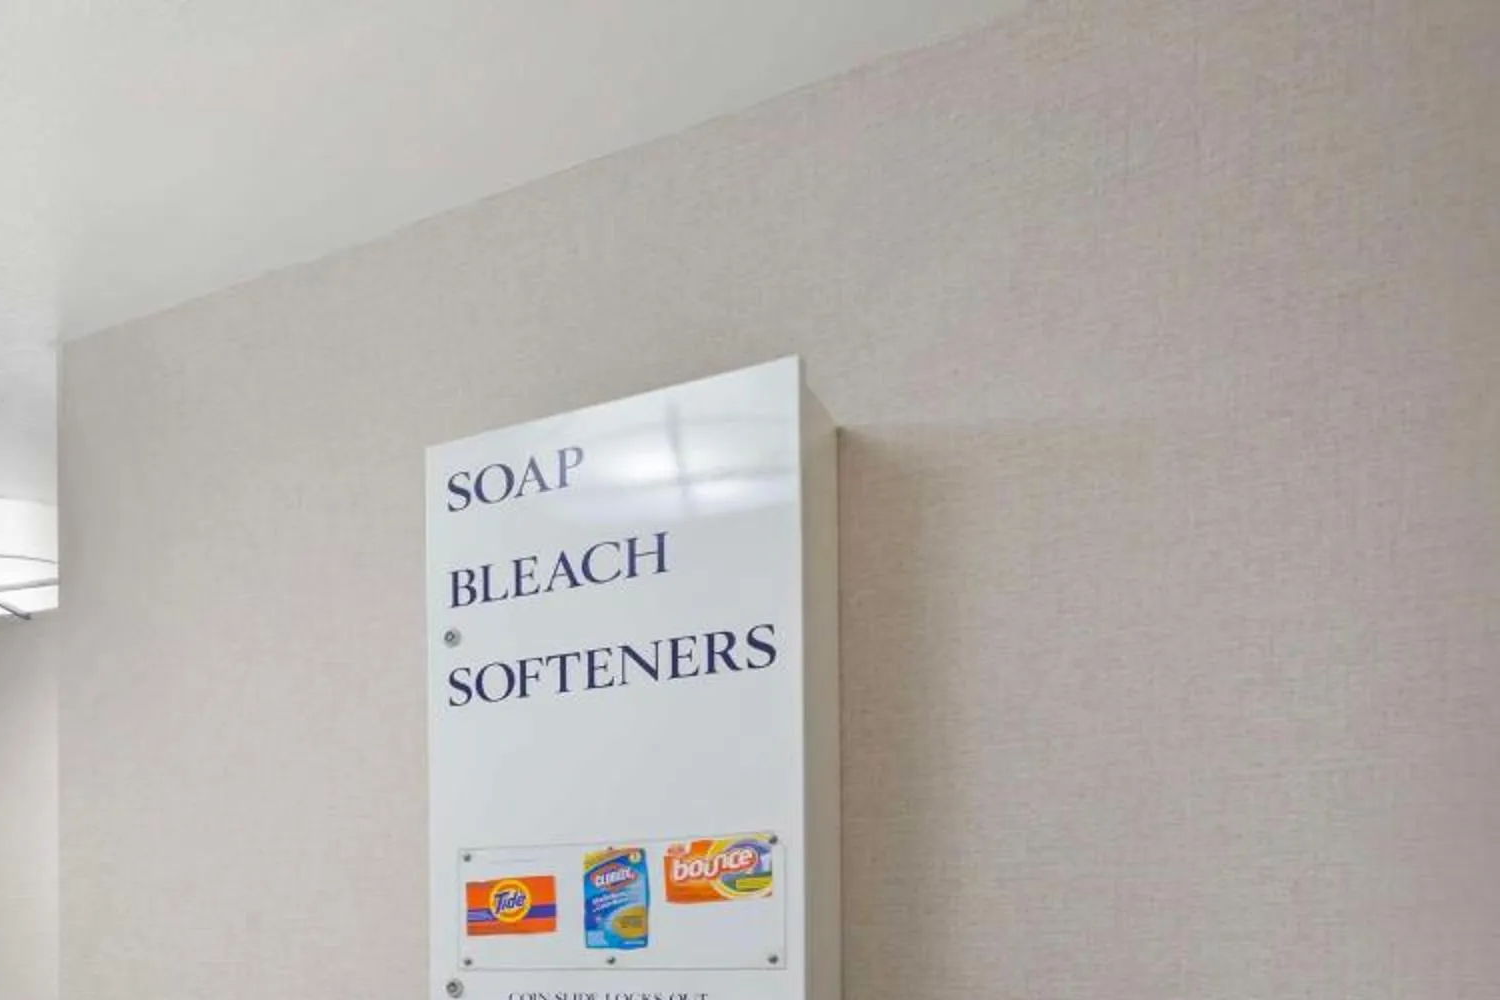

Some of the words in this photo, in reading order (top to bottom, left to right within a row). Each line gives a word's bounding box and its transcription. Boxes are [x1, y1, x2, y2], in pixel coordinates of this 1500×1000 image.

[446, 446, 584, 512] SOAP
[449, 531, 670, 608] BLEACH
[447, 624, 778, 707] SOFTENERS
[493, 888, 526, 914] Tide
